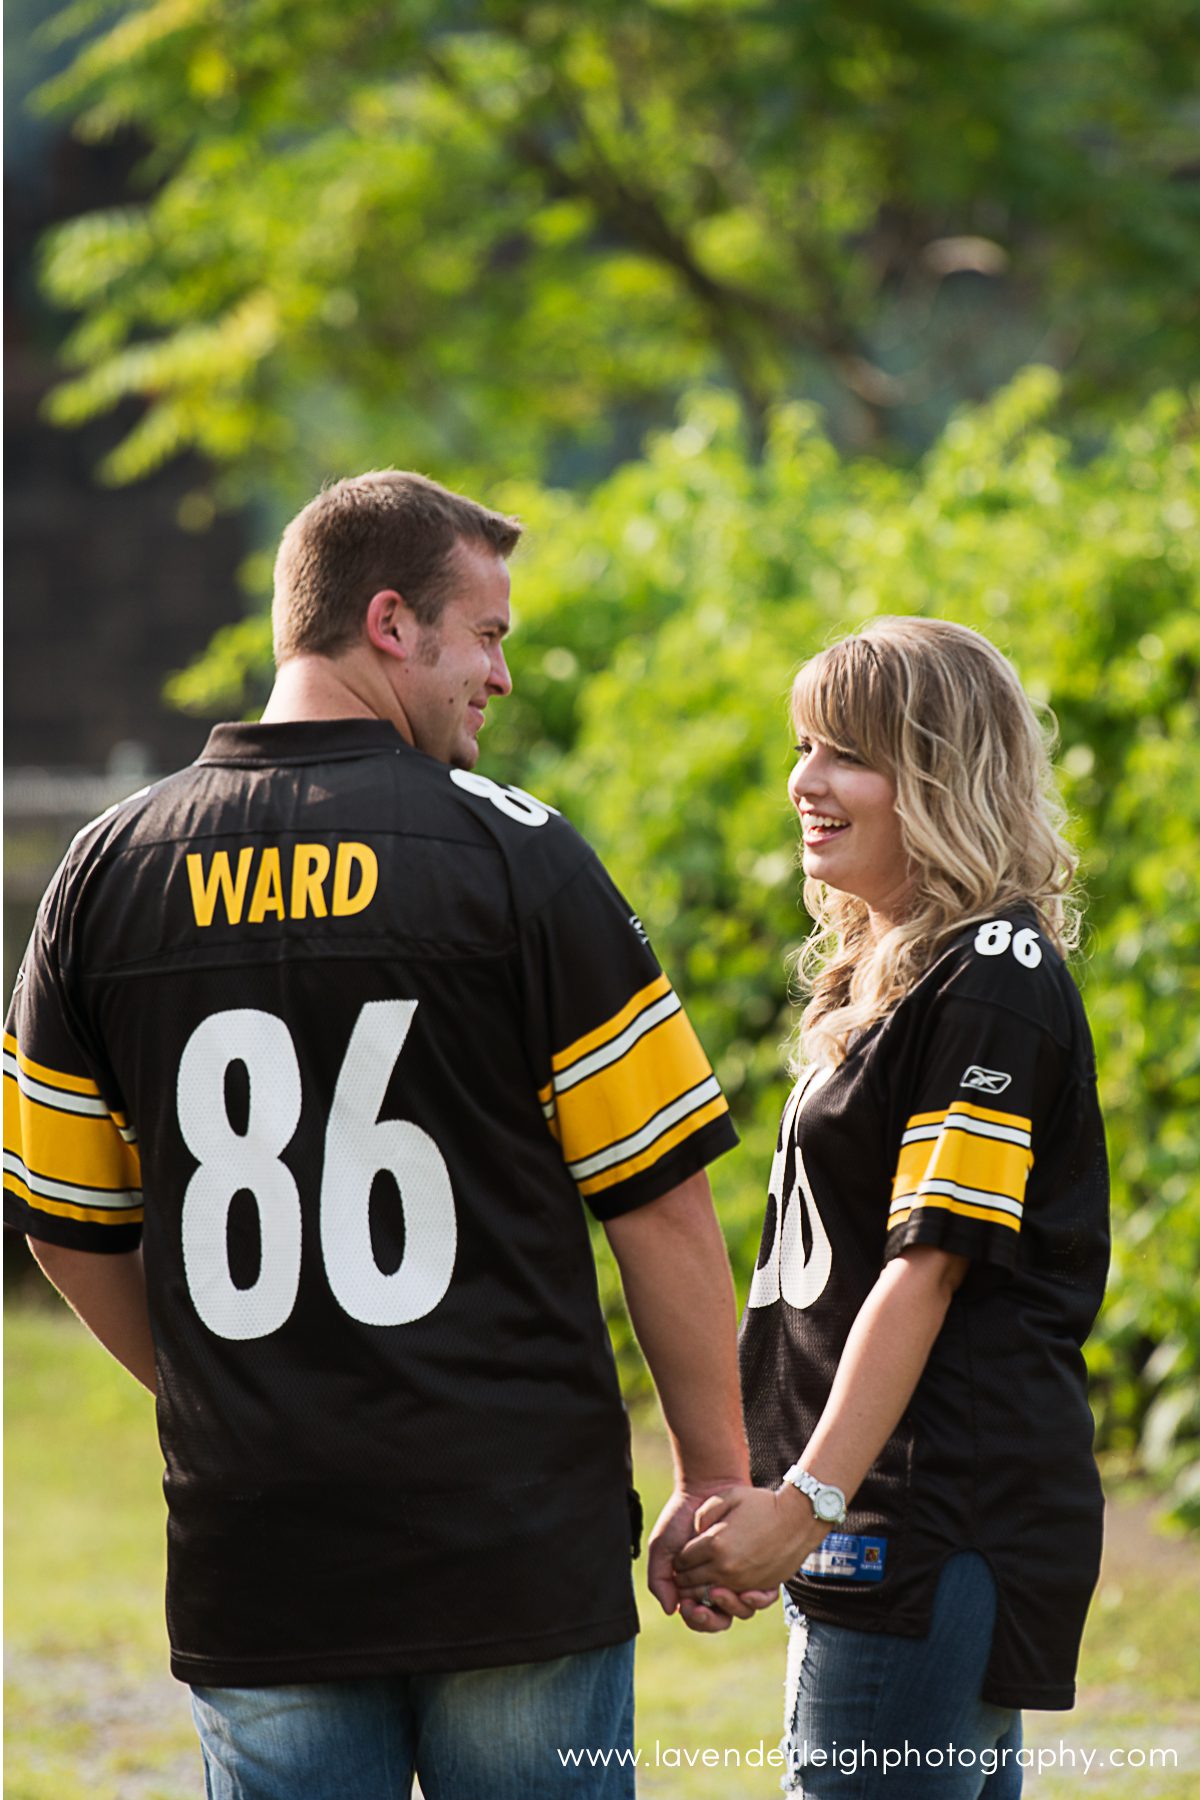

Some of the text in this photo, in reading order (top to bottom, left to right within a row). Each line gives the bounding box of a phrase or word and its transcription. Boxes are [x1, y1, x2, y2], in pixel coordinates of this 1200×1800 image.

[186, 842, 379, 927] WARD
[974, 919, 1043, 969] 86
[177, 999, 457, 1340] 86
